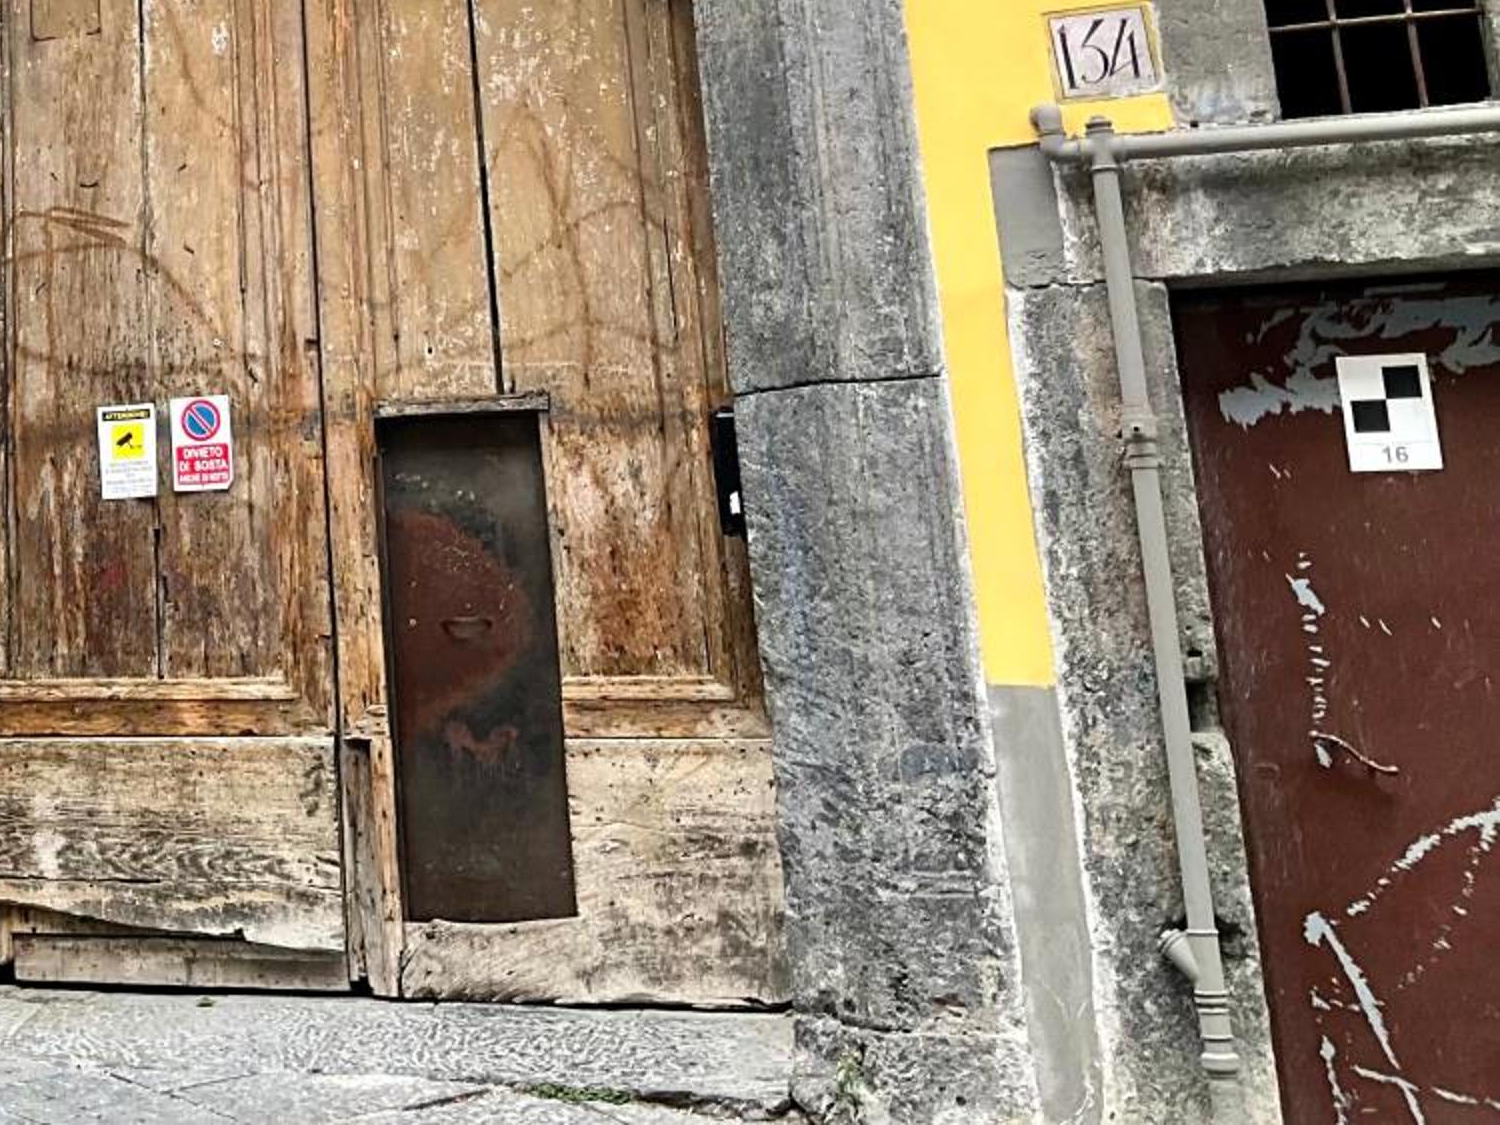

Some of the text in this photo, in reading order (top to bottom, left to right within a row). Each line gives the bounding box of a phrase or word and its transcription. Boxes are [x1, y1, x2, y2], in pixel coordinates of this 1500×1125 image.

[1057, 17, 1141, 90] 154
[183, 446, 222, 459] DIVIETO
[1382, 445, 1409, 464] 16
[180, 458, 228, 472] DI SOSTA
